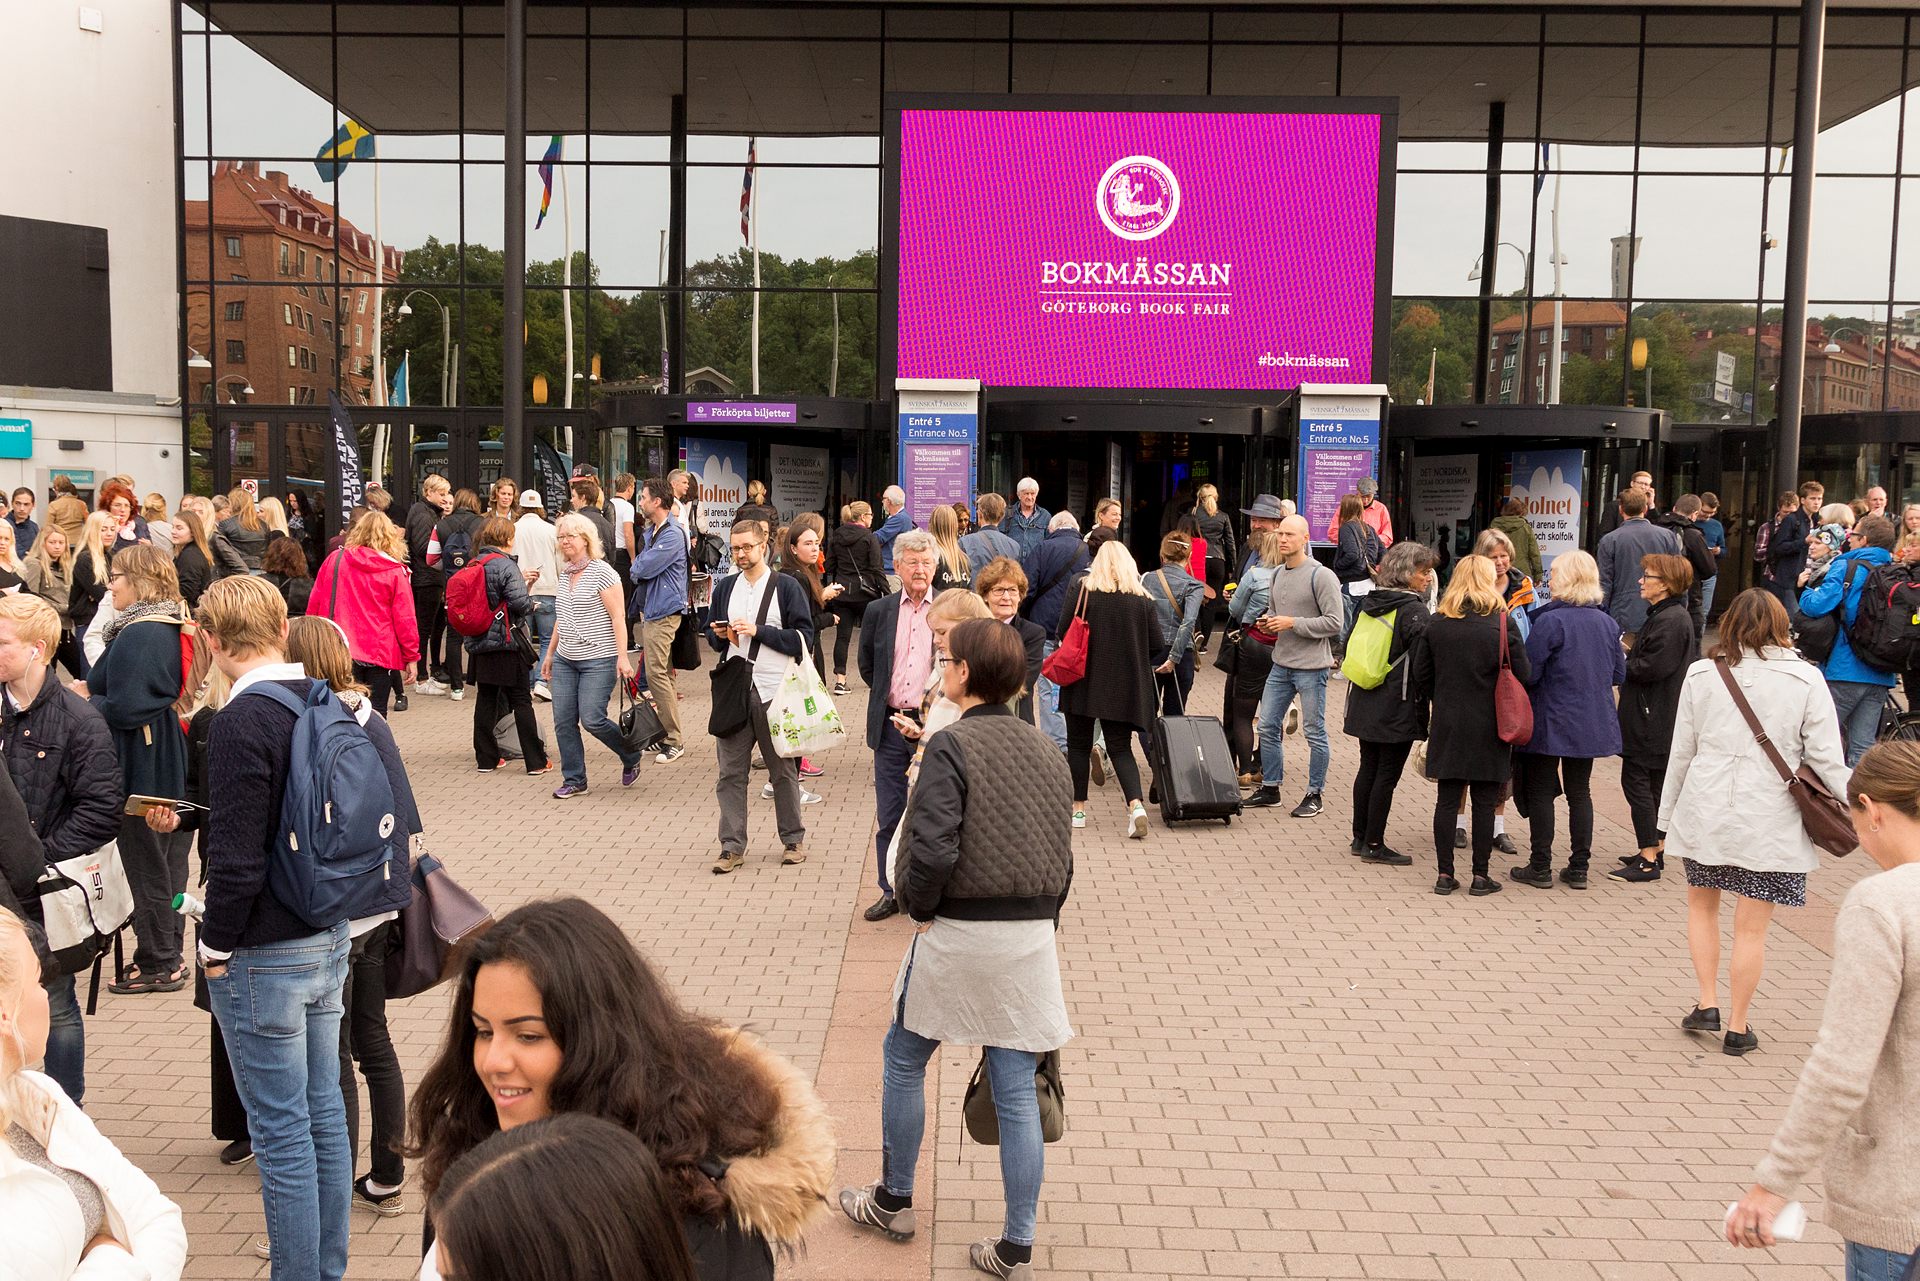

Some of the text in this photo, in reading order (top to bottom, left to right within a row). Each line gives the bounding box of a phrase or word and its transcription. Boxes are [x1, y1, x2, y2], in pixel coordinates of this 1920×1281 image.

[1042, 256, 1232, 286] BOKMÄSSAN
[1042, 300, 1230, 315] GÖTEBORG BOOK FAIR
[1258, 352, 1350, 368] #bokmässan
[712, 407, 752, 418] Förköpta
[754, 408, 790, 419] biljetter
[909, 417, 932, 426] Entré
[0, 424, 26, 432] omat
[1310, 423, 1343, 432] Entré 5
[909, 429, 968, 438] Entrance No.5
[1310, 435, 1369, 444] Entrance No.5
[1525, 496, 1572, 515] olnet
[1558, 520, 1567, 529] för
[1548, 532, 1574, 540] skolfolk
[1538, 591, 1550, 599] skol
[92, 872, 103, 900] SR
